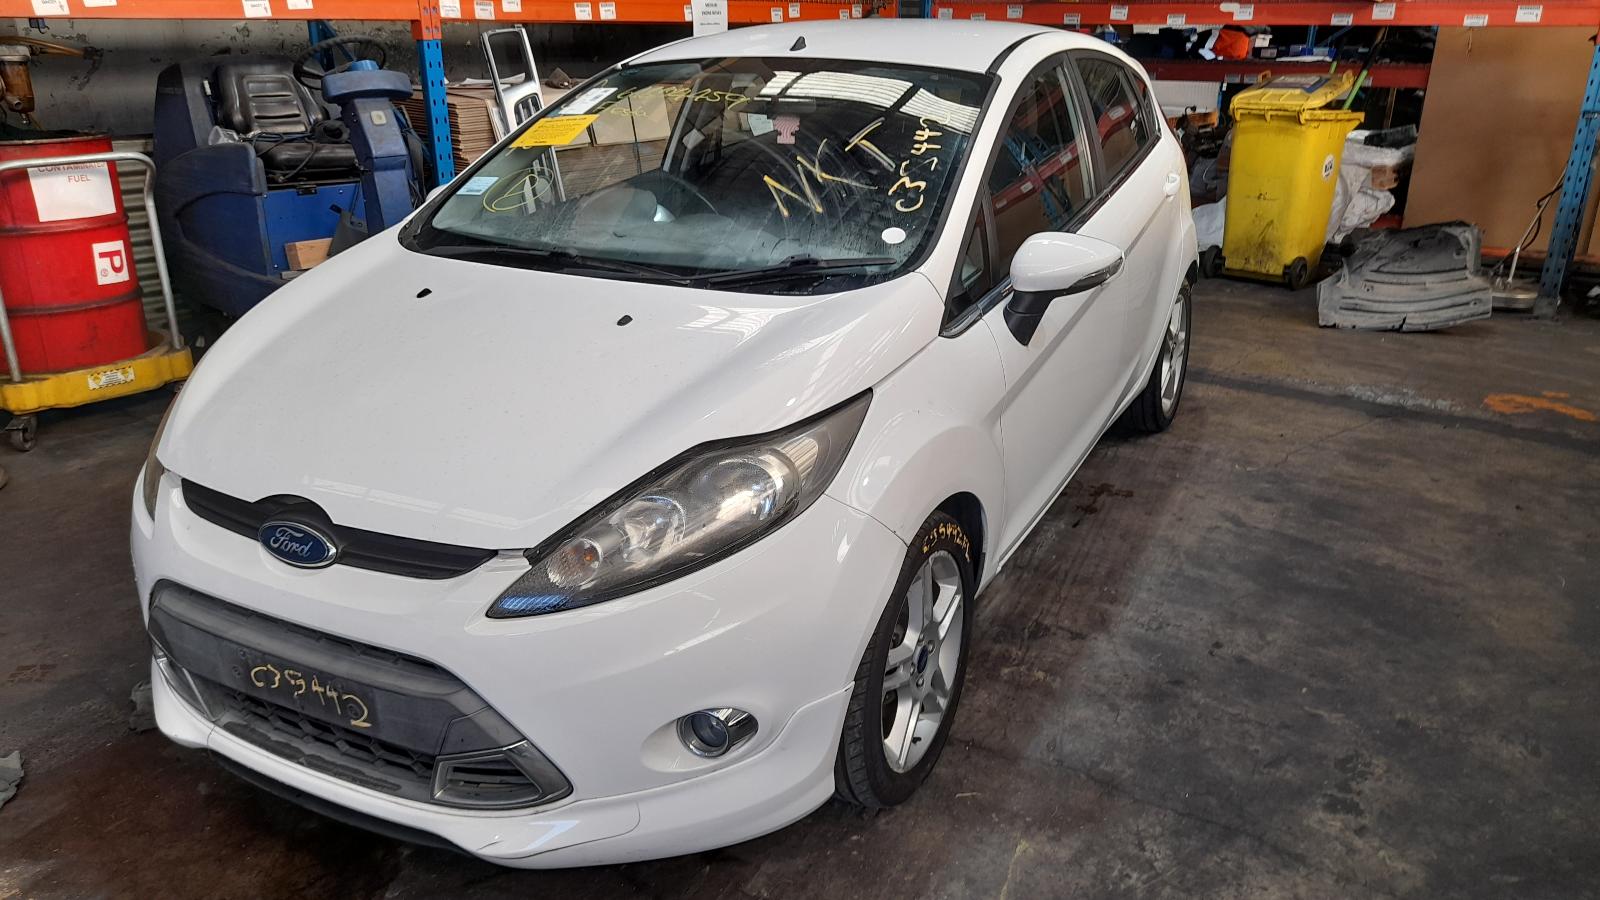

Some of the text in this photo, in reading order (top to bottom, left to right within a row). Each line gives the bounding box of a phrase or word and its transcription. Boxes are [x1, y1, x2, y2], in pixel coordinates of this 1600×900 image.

[67, 175, 91, 183] FUEL
[98, 249, 124, 273] P
[269, 525, 311, 559] Ford
[250, 664, 372, 728] C35442
